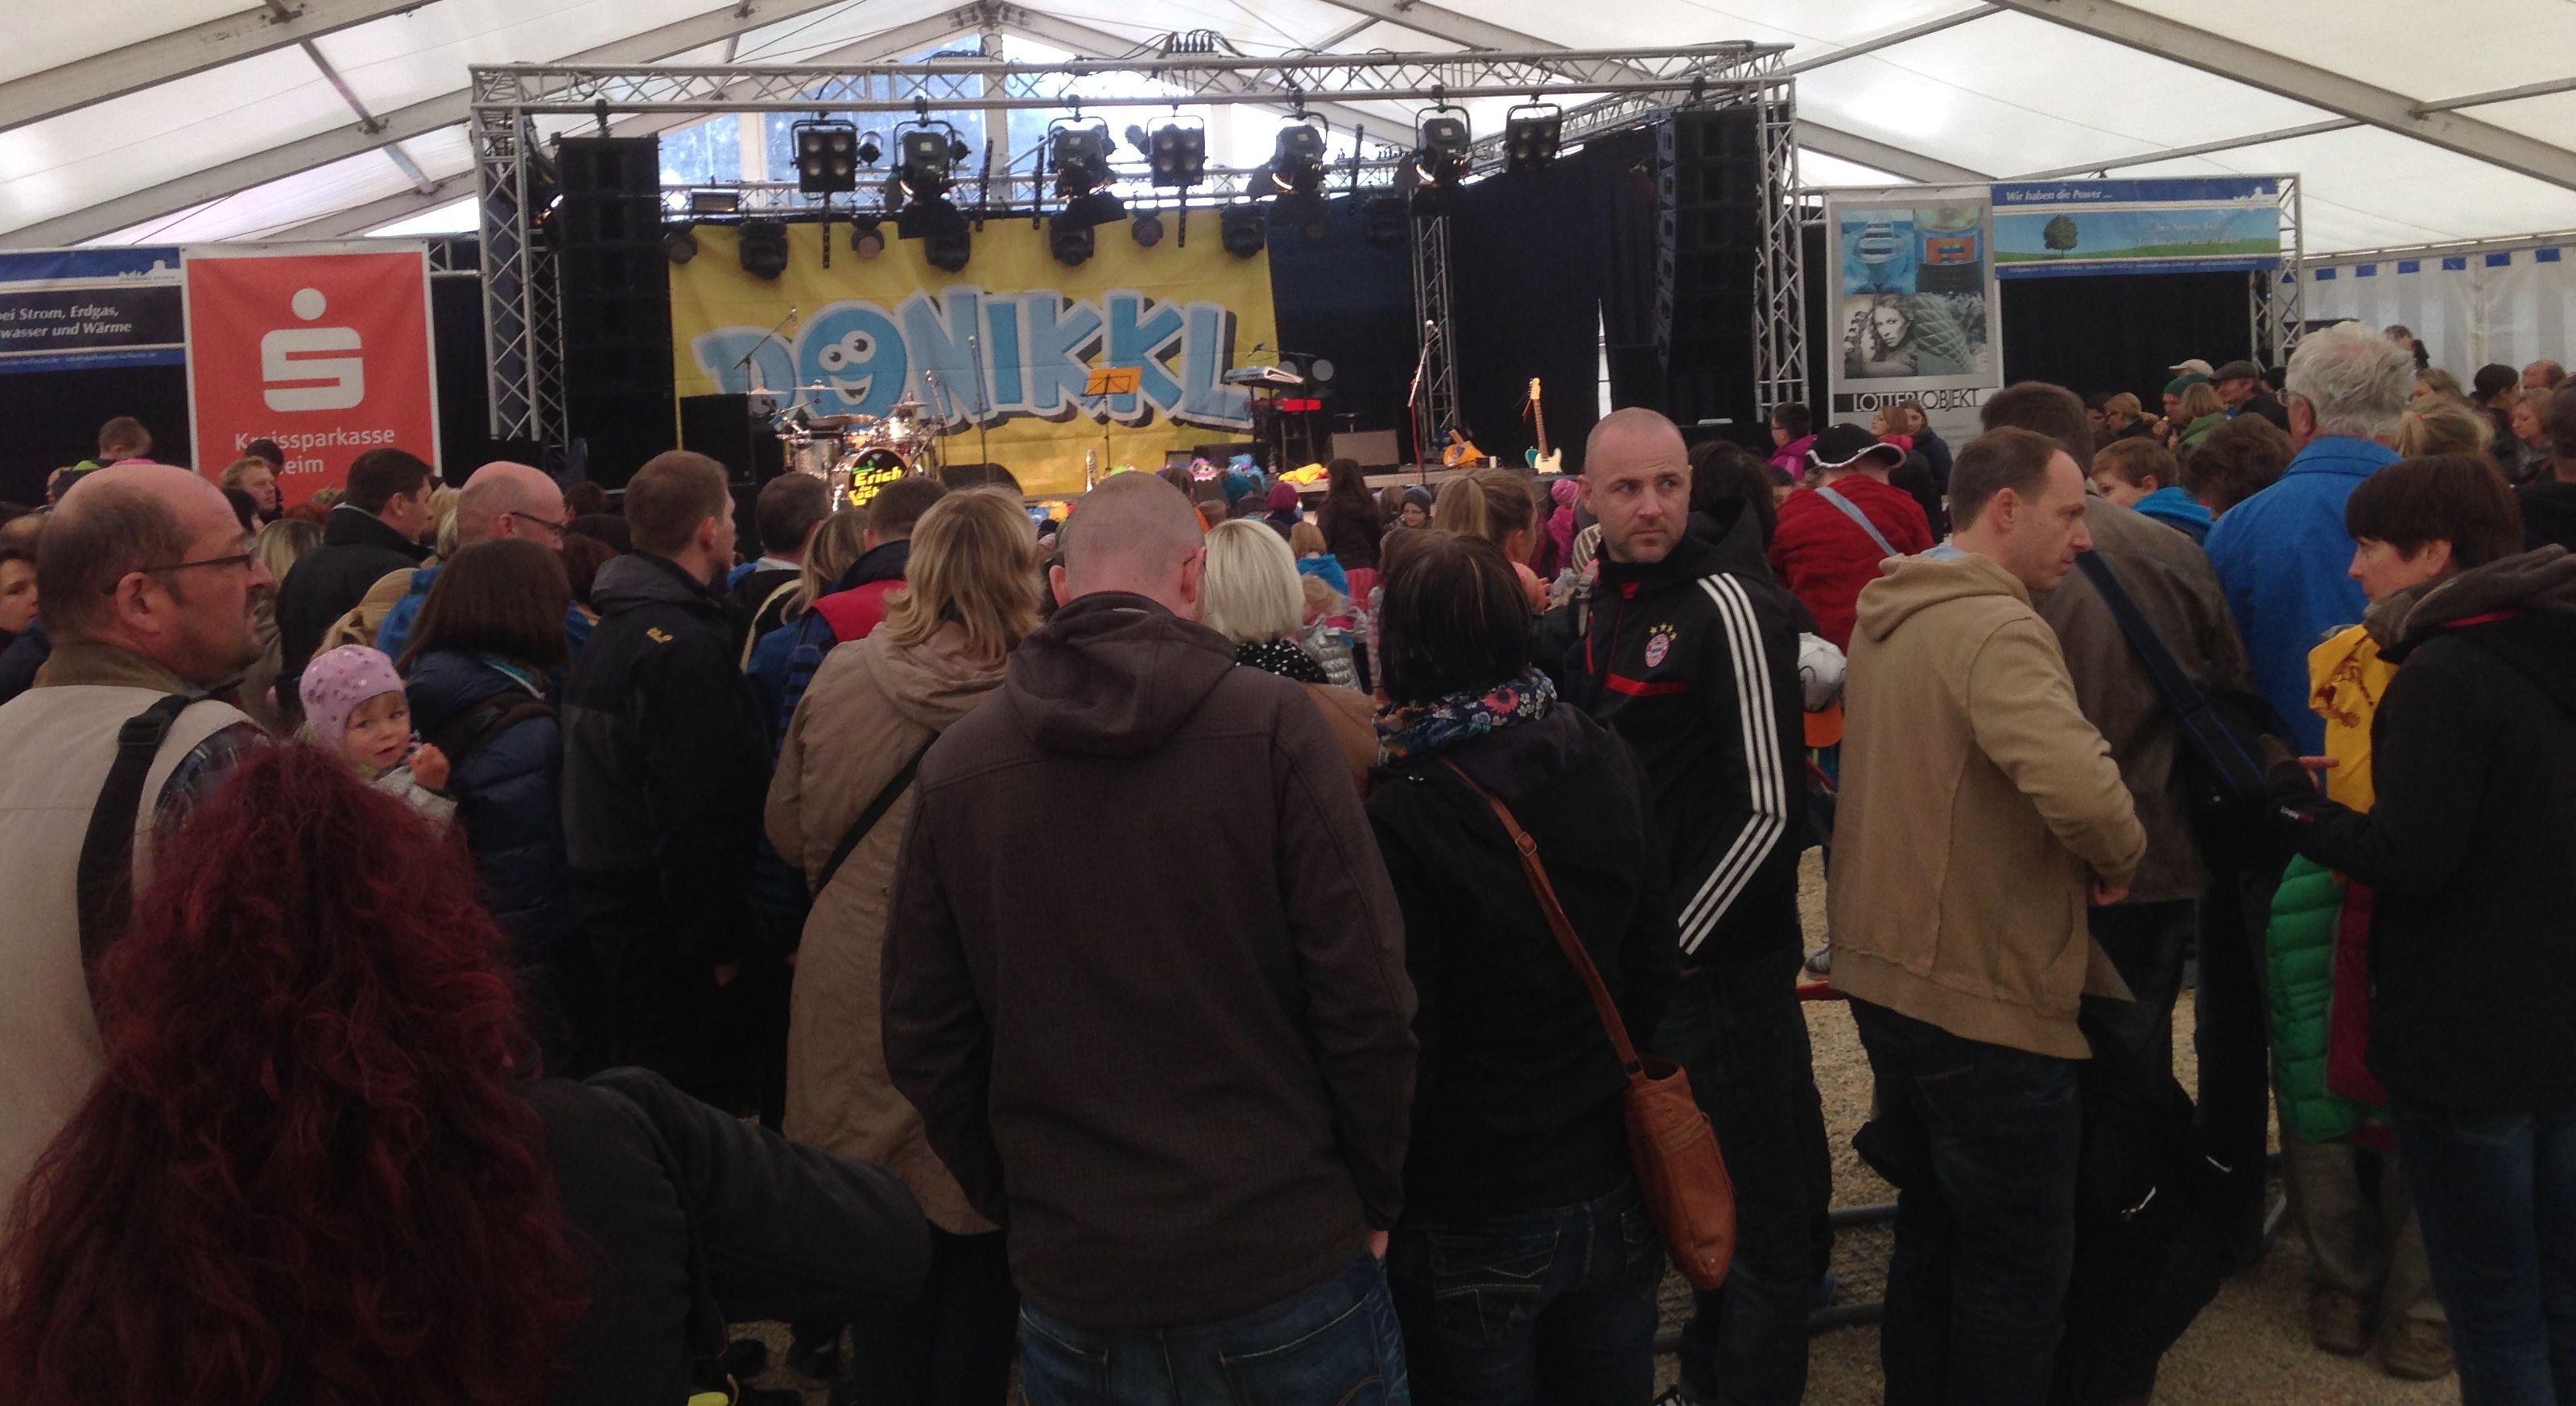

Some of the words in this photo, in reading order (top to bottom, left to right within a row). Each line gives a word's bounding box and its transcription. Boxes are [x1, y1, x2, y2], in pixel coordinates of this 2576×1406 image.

[2006, 190, 2023, 201] Wir
[2025, 190, 2055, 200] haben
[2056, 188, 2071, 200] die
[2073, 189, 2101, 199] Power
[19, 307, 65, 320] Strom,
[70, 303, 119, 320] Erdgas,
[52, 322, 80, 336] und
[83, 320, 132, 334] Wärme
[234, 427, 395, 451] Kissparkasse
[854, 466, 902, 487] Erich
